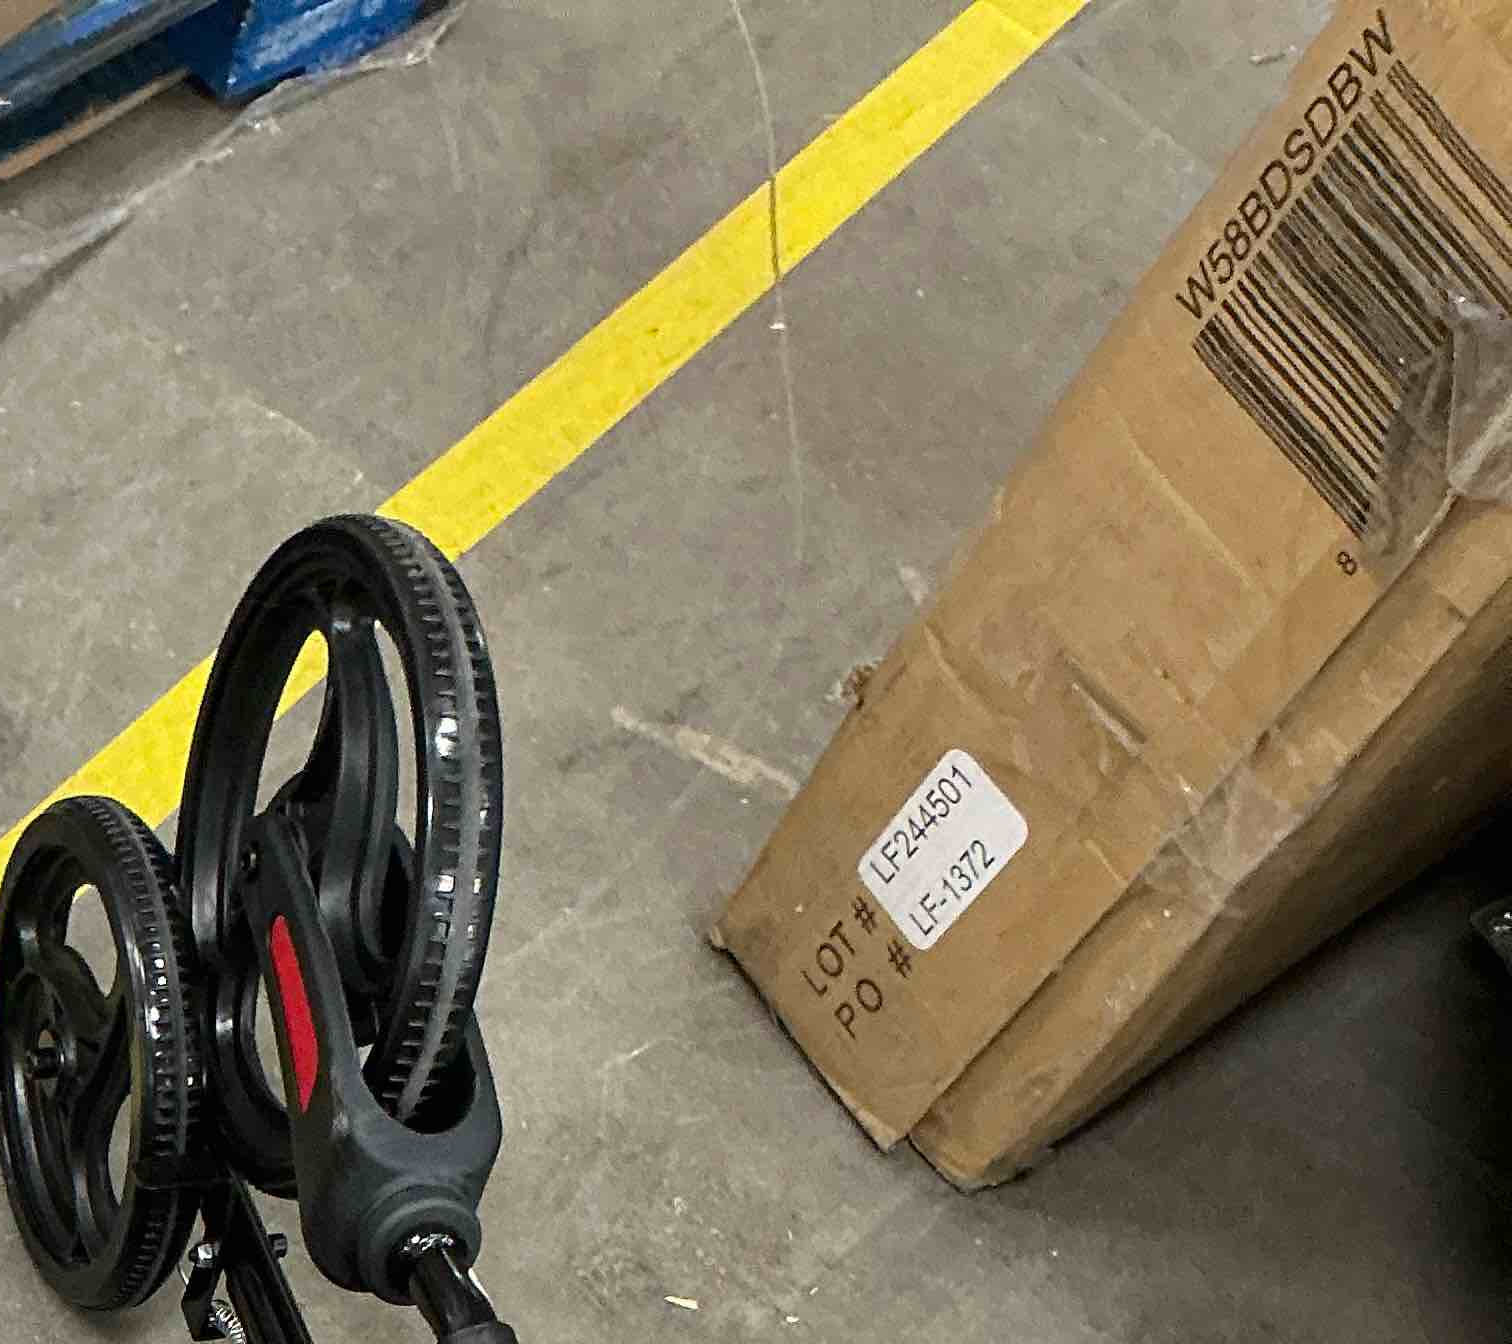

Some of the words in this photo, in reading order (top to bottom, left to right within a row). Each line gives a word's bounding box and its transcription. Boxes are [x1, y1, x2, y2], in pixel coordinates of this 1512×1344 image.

[1174, 10, 1397, 322] W58BDSDBW
[868, 765, 973, 885] LF244501
[909, 838, 996, 938] LF-1372
[799, 920, 863, 996] LOT
[853, 896, 878, 936] #
[835, 980, 884, 1041] PO
[887, 943, 913, 978] #
